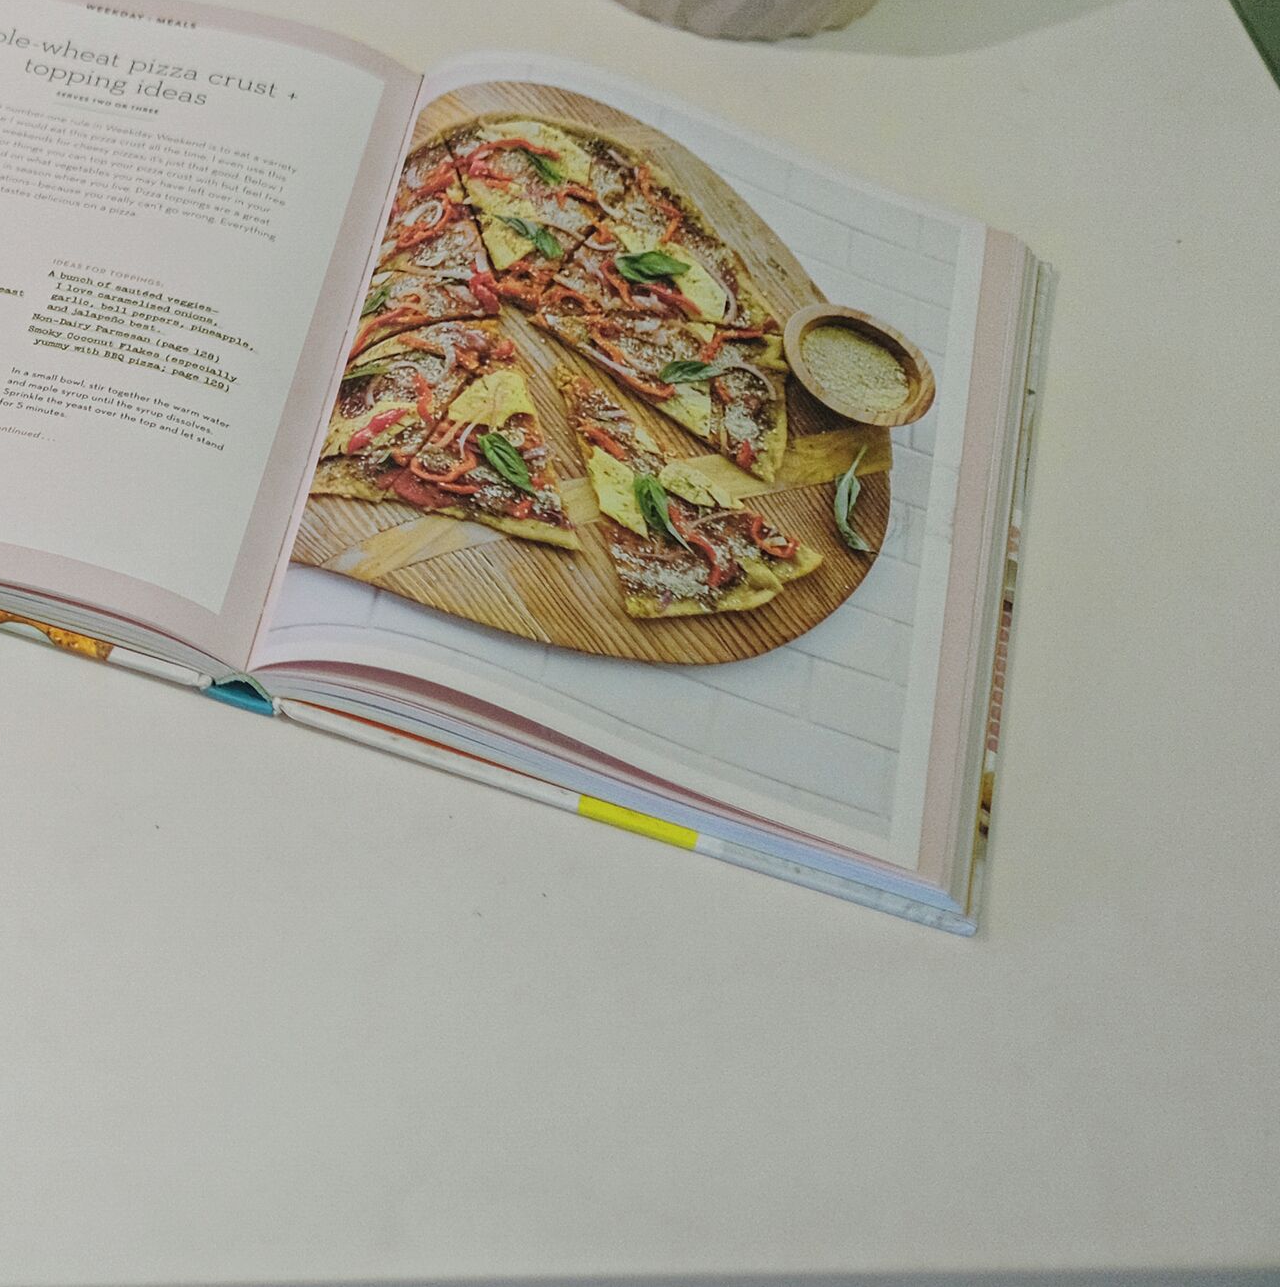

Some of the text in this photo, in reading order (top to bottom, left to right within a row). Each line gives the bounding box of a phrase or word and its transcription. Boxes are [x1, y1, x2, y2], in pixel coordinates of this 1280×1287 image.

[85, 3, 196, 29] WEEKDAY MEALS
[24, 56, 208, 106] topping ideas
[128, 57, 199, 83] pizza
[207, 70, 279, 99] crust
[59, 271, 94, 286] bunch
[96, 280, 112, 289] of
[46, 303, 161, 334] and jalapeño best.
[49, 293, 254, 352] garlic, bell peppers, pineapple,
[65, 283, 94, 296] love
[96, 292, 171, 314] caramelized
[173, 308, 218, 327] onions,
[27, 324, 238, 383] Smoky Coconut Flakes (especially
[31, 312, 92, 331] Non-Dairy
[94, 324, 151, 344] Parmesan
[155, 338, 190, 353] (page
[32, 338, 71, 351] yummy
[73, 345, 100, 356] with
[102, 349, 125, 363] BBQ
[126, 356, 167, 373] pizza;
[170, 368, 200, 382] page
[2, 386, 225, 451] Sprinkle the yeast over the top and let stand
[6, 378, 27, 387] and
[27, 382, 59, 394] maple
[60, 388, 89, 400] syrup
[90, 395, 115, 405] until
[115, 399, 133, 410] the
[135, 406, 164, 419] syrup
[31, 372, 59, 382] small
[88, 382, 105, 392] stir
[107, 386, 151, 403] together
[152, 397, 170, 408] the
[172, 404, 200, 418] warm
[202, 414, 230, 429] water
